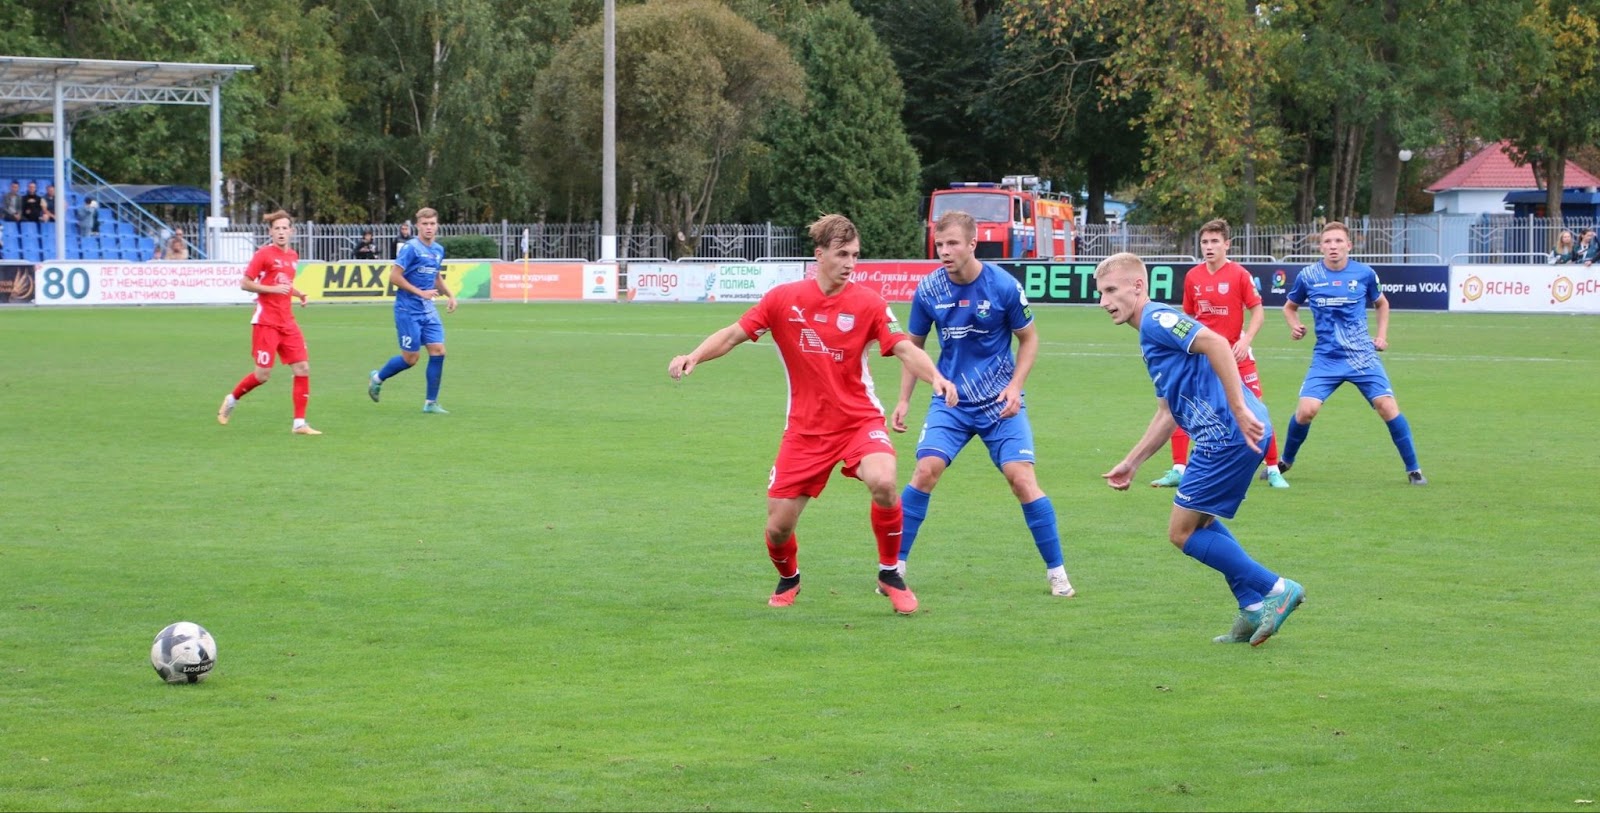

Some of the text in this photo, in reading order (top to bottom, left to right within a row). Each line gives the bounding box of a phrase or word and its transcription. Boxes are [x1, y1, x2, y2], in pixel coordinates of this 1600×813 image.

[984, 229, 991, 241] 1
[100, 266, 118, 276] ЛЕТ
[122, 266, 214, 277] ОСВОБОЖДЕНИЯ
[720, 266, 762, 276] СИСТЕМЫ
[43, 267, 90, 300] 80
[100, 278, 113, 287] ОТ
[638, 267, 678, 292] amigo
[720, 279, 755, 290] ПОЛИВА
[1380, 282, 1448, 294] порт на VOKA
[1468, 284, 1479, 292] TV
[1557, 285, 1568, 293] TV
[101, 291, 175, 300] ЗАХВАТЧИКОВ
[401, 335, 412, 349] 12
[257, 350, 270, 365] 10
